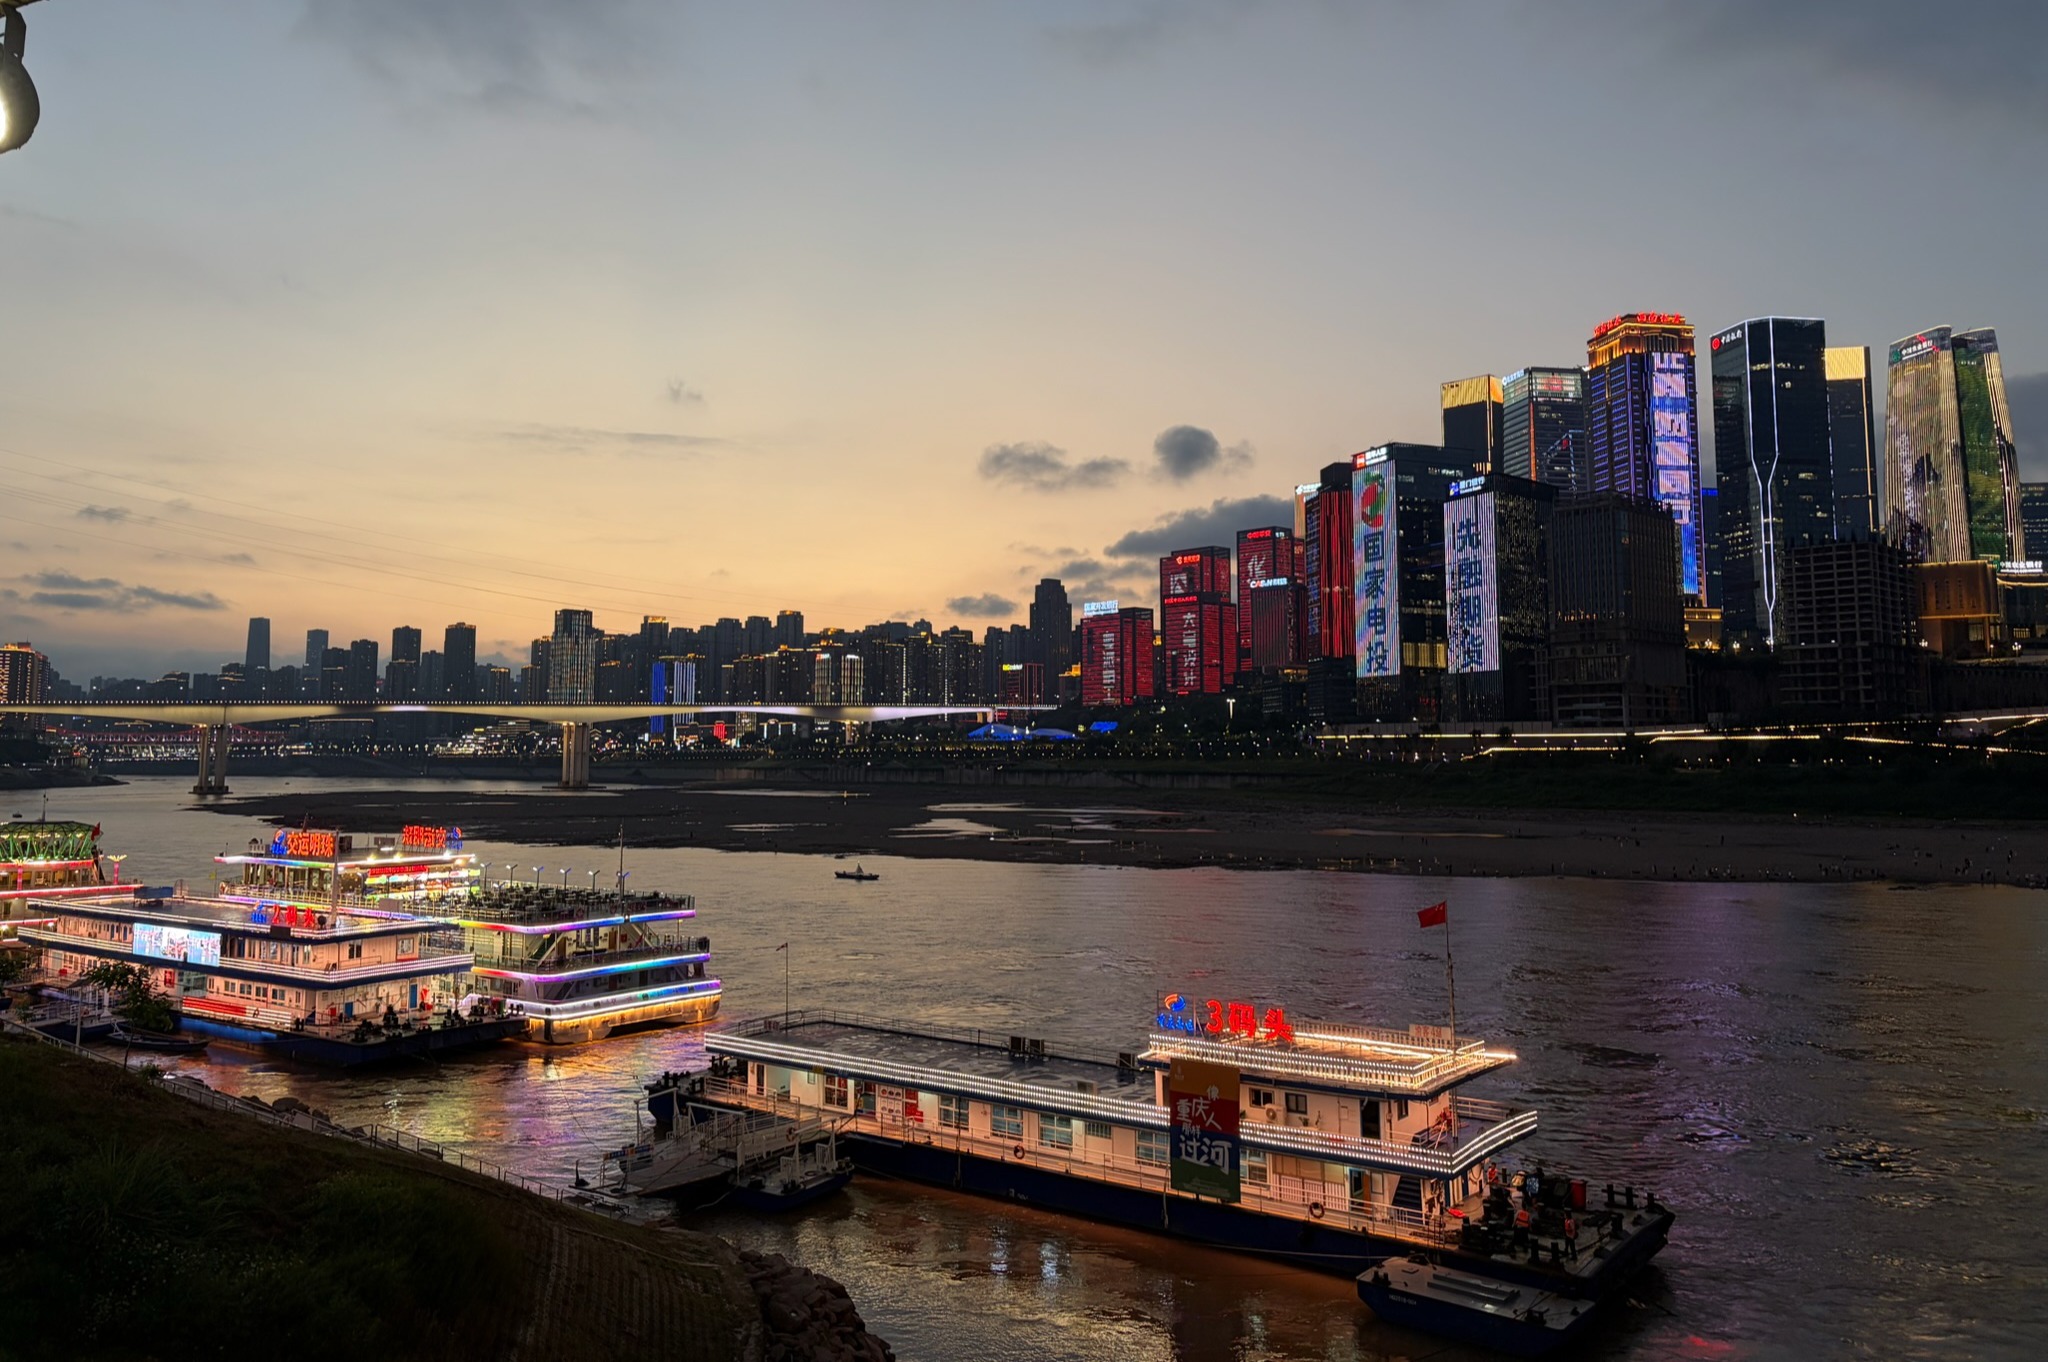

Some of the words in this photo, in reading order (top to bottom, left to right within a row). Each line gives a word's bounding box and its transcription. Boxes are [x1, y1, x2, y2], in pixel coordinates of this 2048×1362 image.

[1999, 560, 2043, 569] 中国农业银行
[1364, 531, 1389, 673] 国家电投
[287, 831, 334, 857] 交运明珠
[272, 904, 316, 928] 2码头
[1206, 999, 1293, 1042] 3码头
[1206, 1084, 1220, 1101] 像
[1176, 1097, 1223, 1131] 重庆人
[1181, 1122, 1202, 1139] 那样
[1179, 1134, 1233, 1176] 过河
